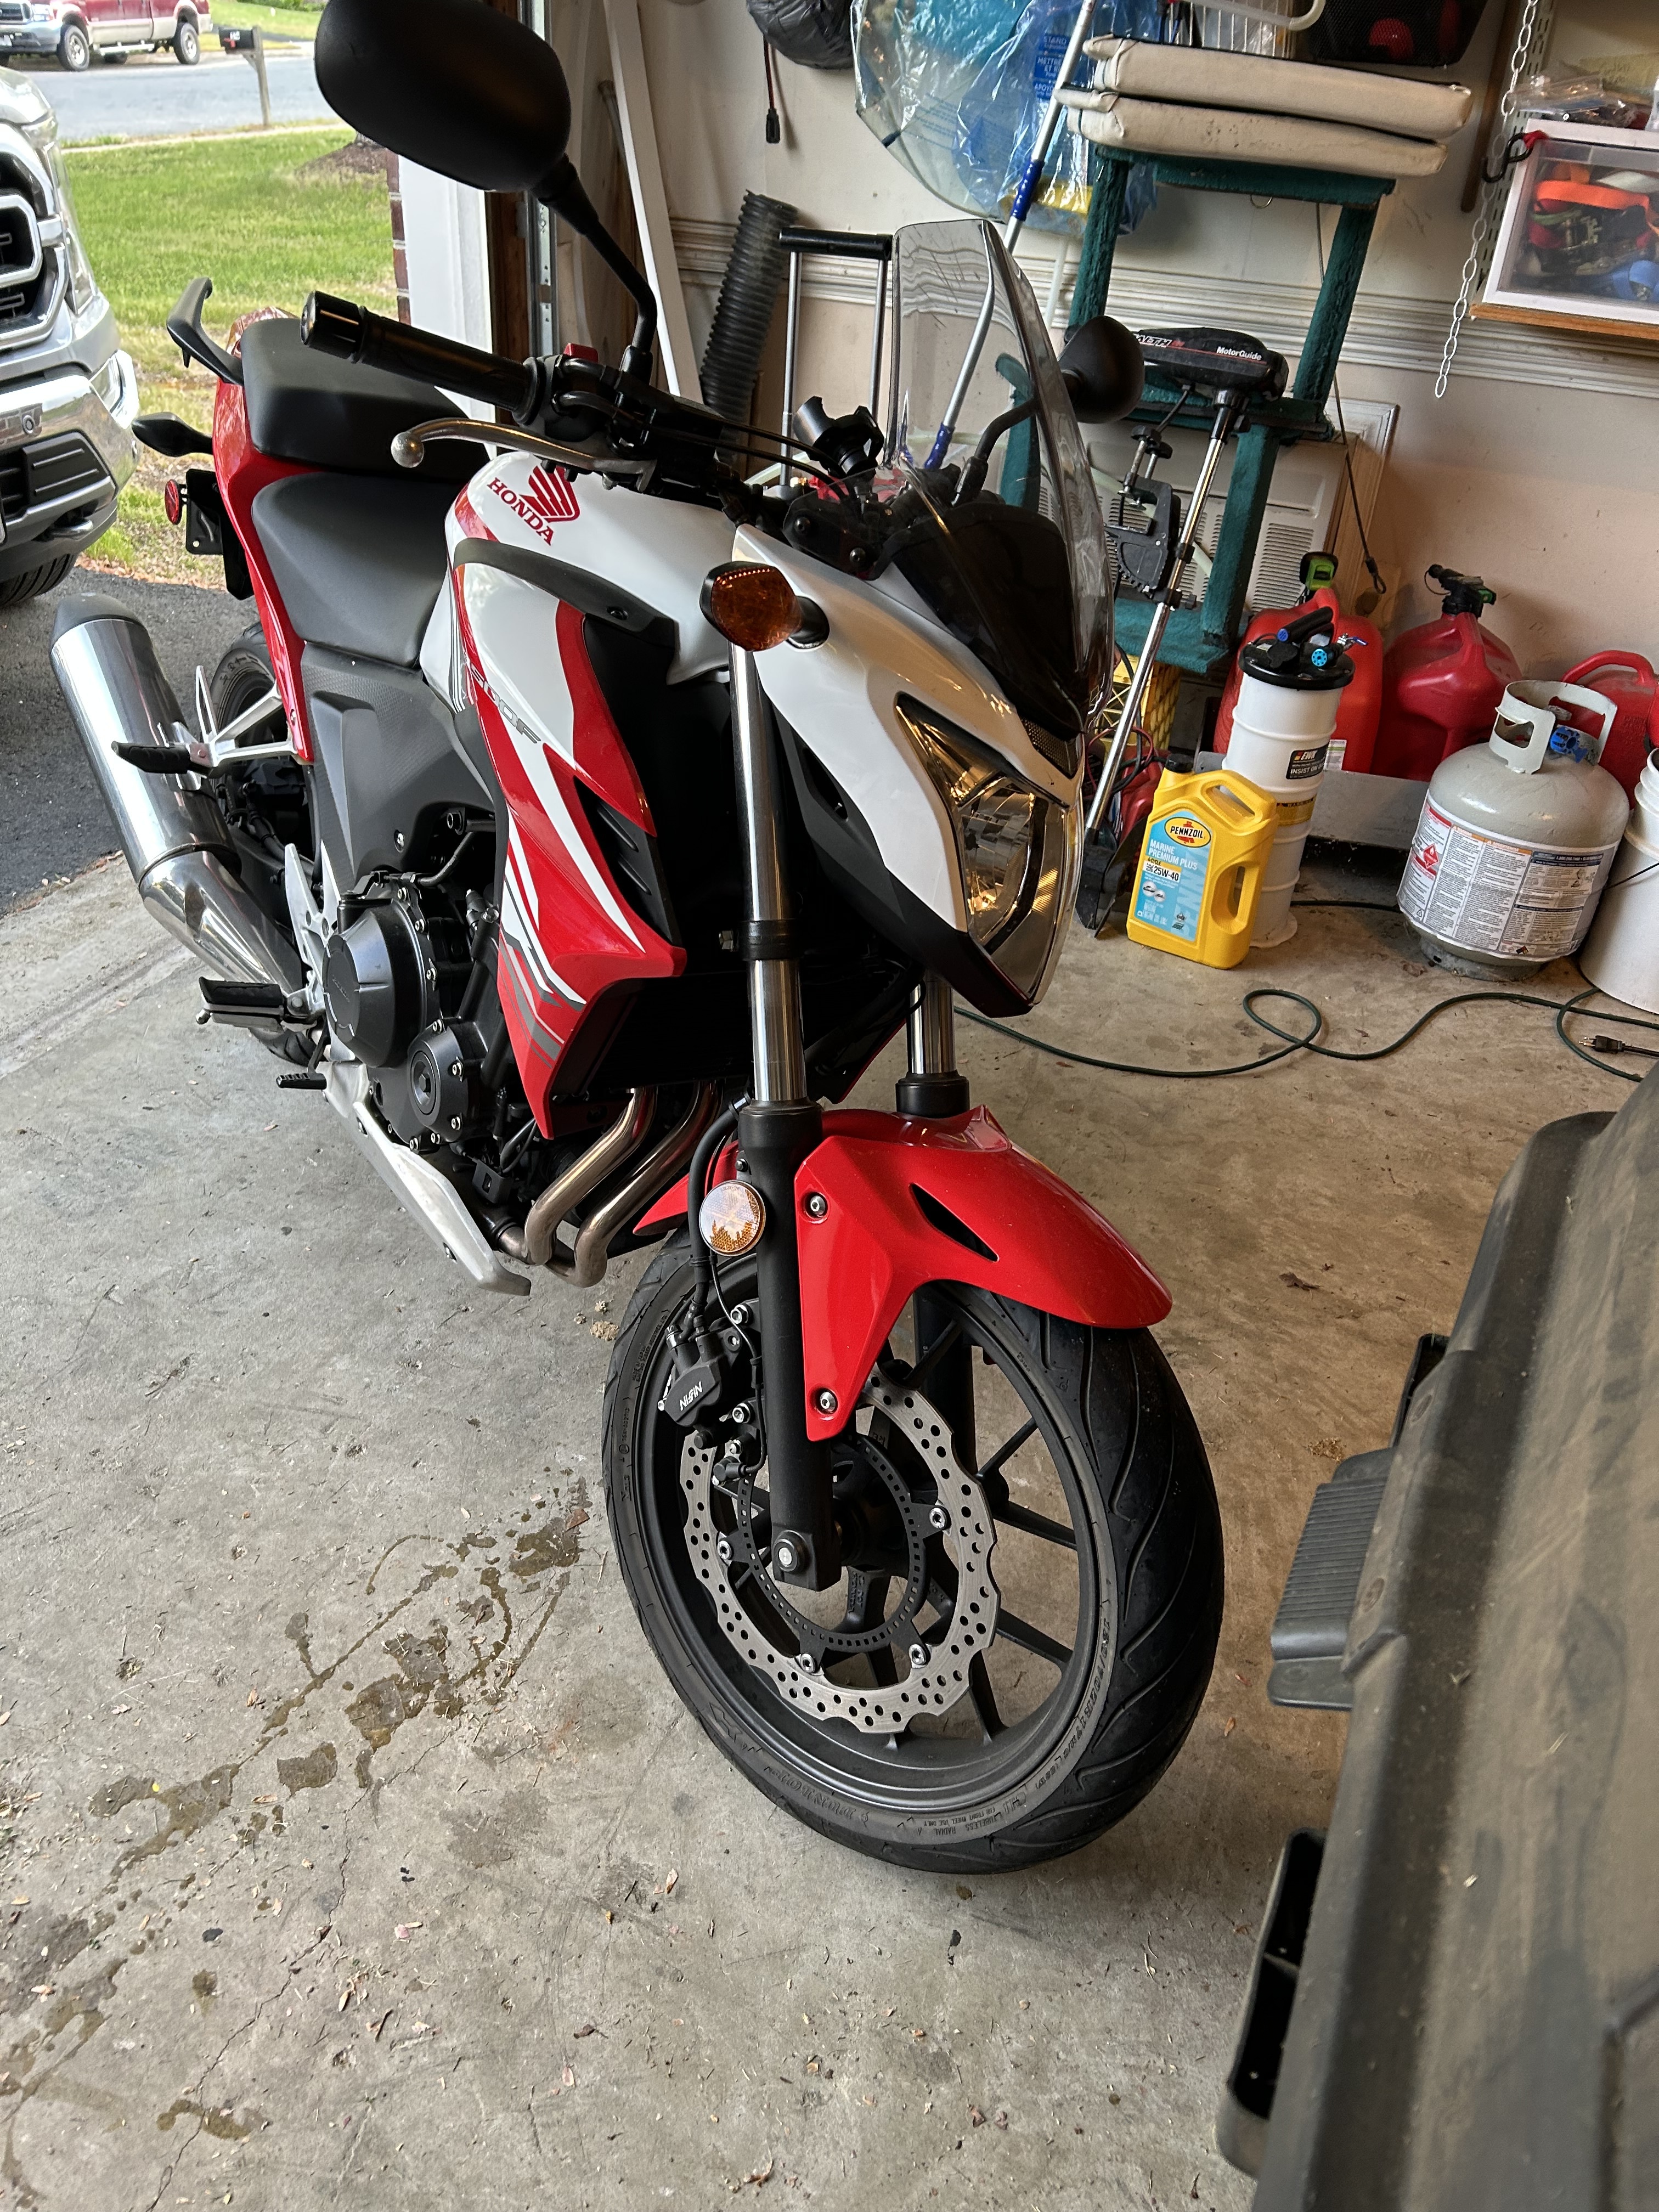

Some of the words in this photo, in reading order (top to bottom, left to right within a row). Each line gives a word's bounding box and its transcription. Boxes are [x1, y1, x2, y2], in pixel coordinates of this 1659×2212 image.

[1216, 346, 1262, 361] MotorGuide
[487, 477, 554, 546] HONDA
[471, 662, 541, 744] 500F
[1170, 826, 1204, 838] PENNZOIL
[1150, 839, 1175, 855] MARINE
[1147, 857, 1161, 866] 4-CYCLE
[1148, 847, 1180, 865] PREMIUM
[1180, 857, 1198, 870] PLUS
[1154, 866, 1180, 882] 25W-40
[771, 1769, 856, 1820] DUNLOP
[952, 1815, 967, 1824] WHEEL
[964, 1815, 997, 1831] TUBELESS
[969, 1812, 985, 1820] FRONT
[935, 1826, 957, 1836] RADIAL
